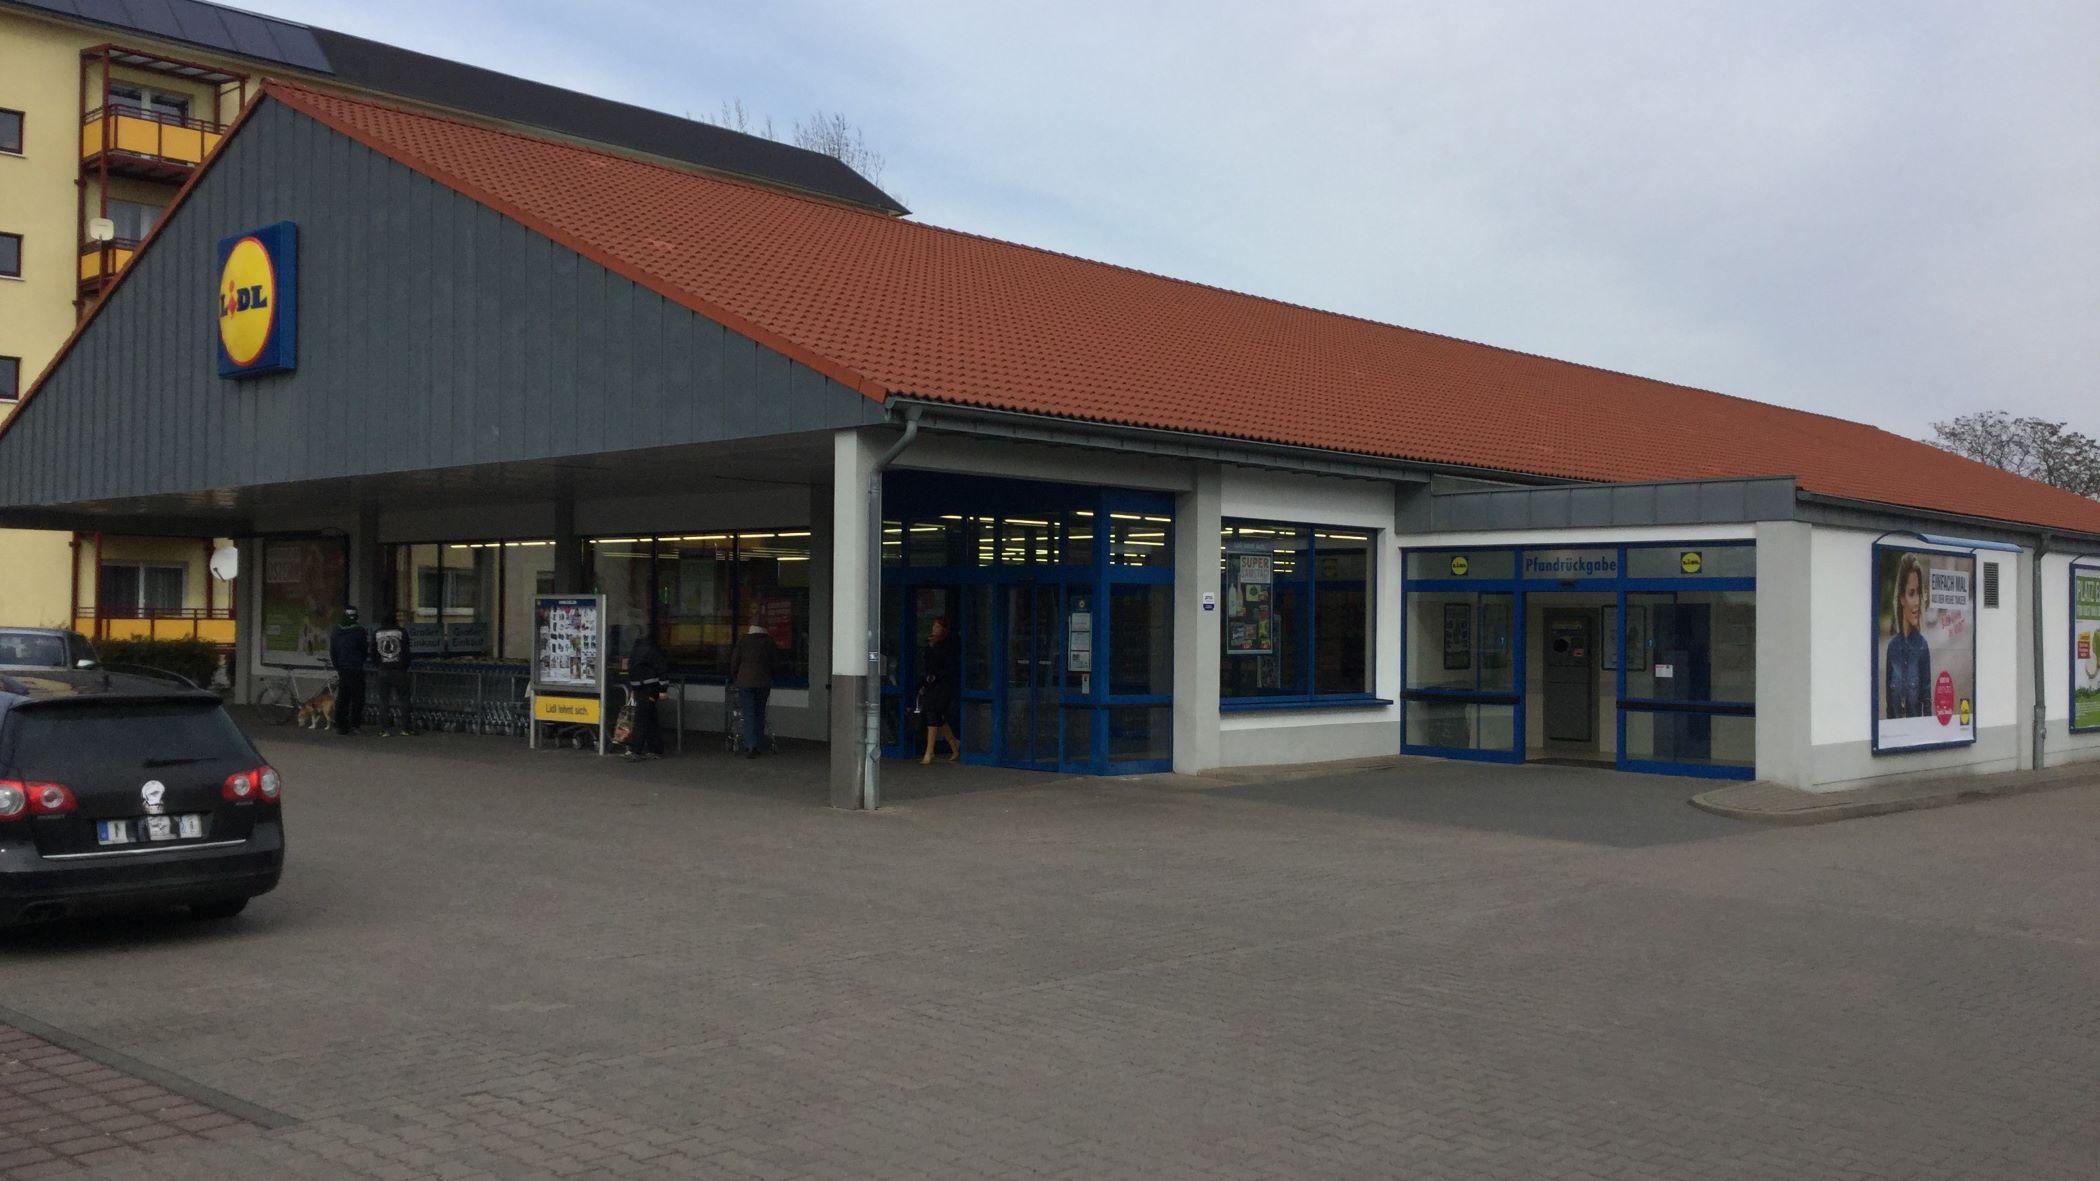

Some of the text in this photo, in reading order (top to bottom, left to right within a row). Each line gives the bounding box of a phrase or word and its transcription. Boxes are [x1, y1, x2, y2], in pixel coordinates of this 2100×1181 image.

[1241, 556, 1269, 568] SUPER
[1525, 557, 1616, 575] Pfandrückgabe
[1932, 573, 1968, 593] EINFACH MAL
